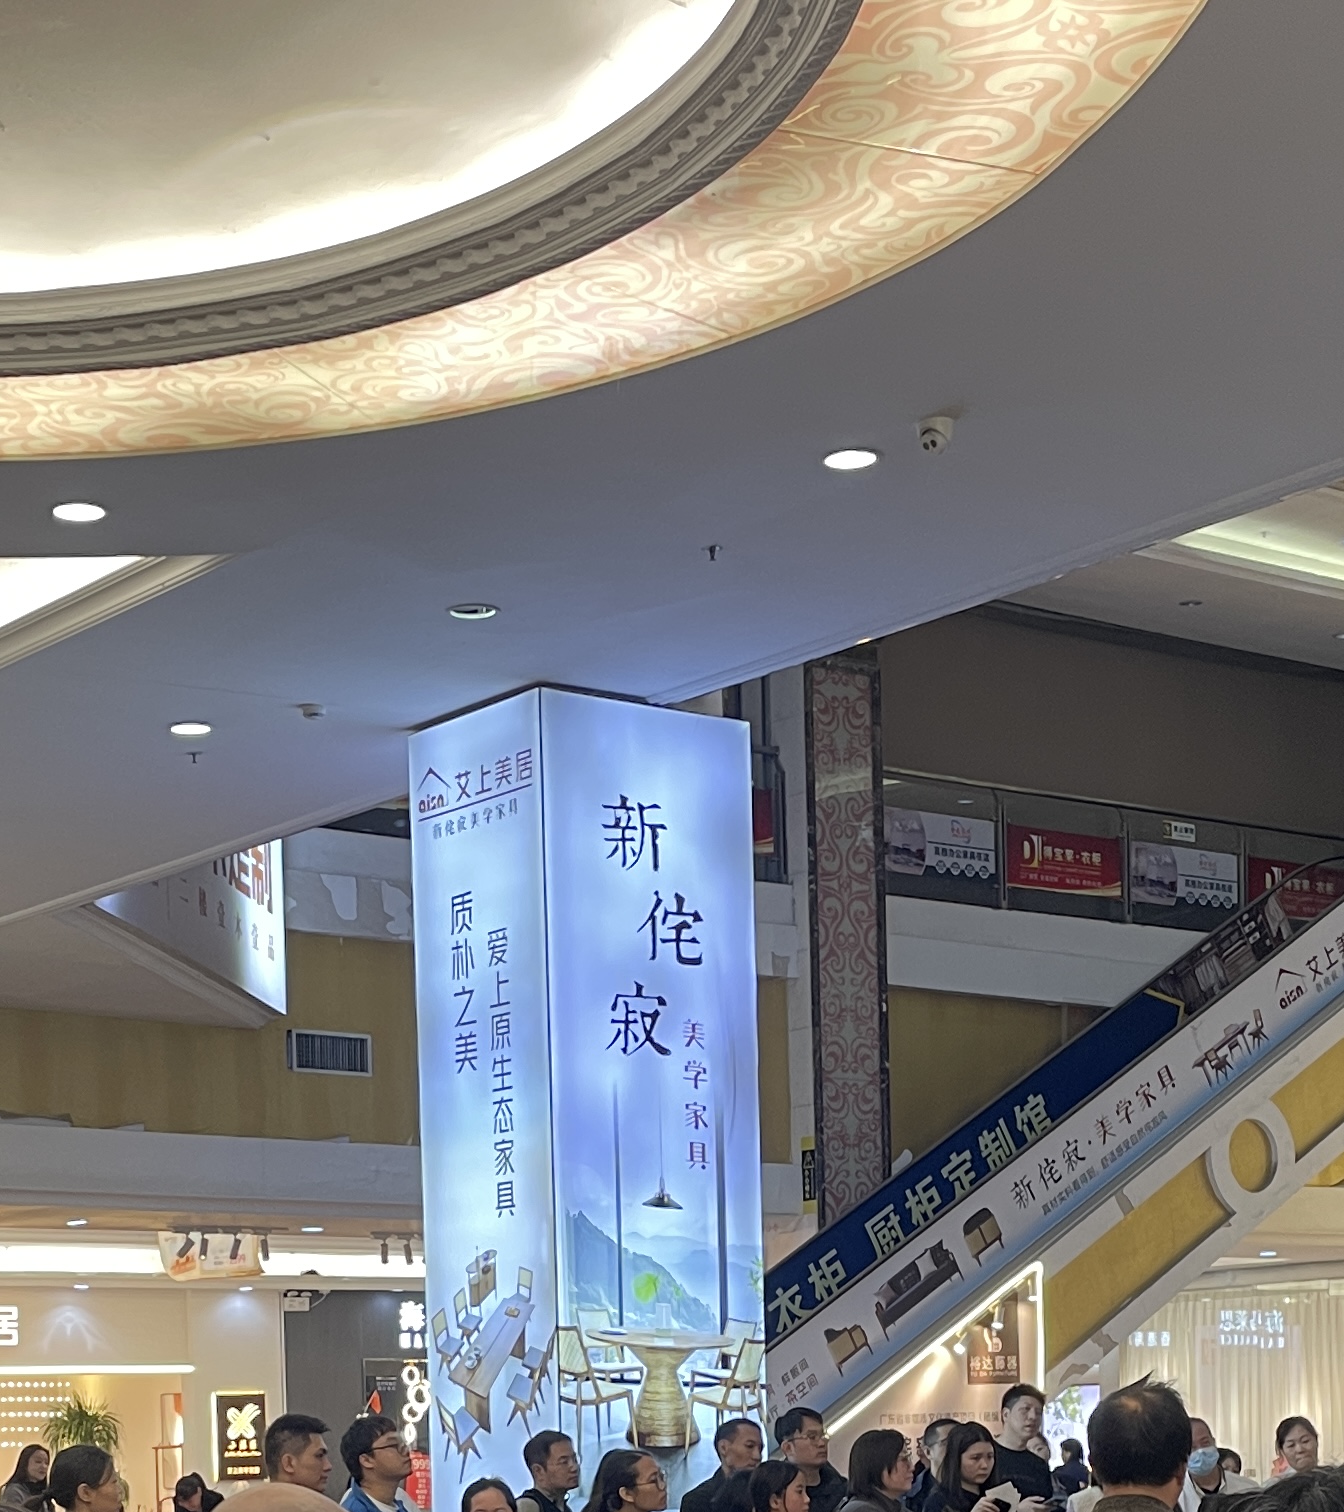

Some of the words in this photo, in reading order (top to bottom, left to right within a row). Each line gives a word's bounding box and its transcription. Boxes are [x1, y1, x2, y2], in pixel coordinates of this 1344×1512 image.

[454, 748, 533, 803] 艾上美居
[450, 890, 479, 1074] 质朴之美
[601, 794, 704, 1057] 新侘寂
[487, 926, 517, 1218] 爱上原生态家具
[682, 1018, 710, 1171] 美学家具
[767, 1248, 847, 1334] 衣柜
[864, 1093, 1056, 1260] 厨柜定制馆
